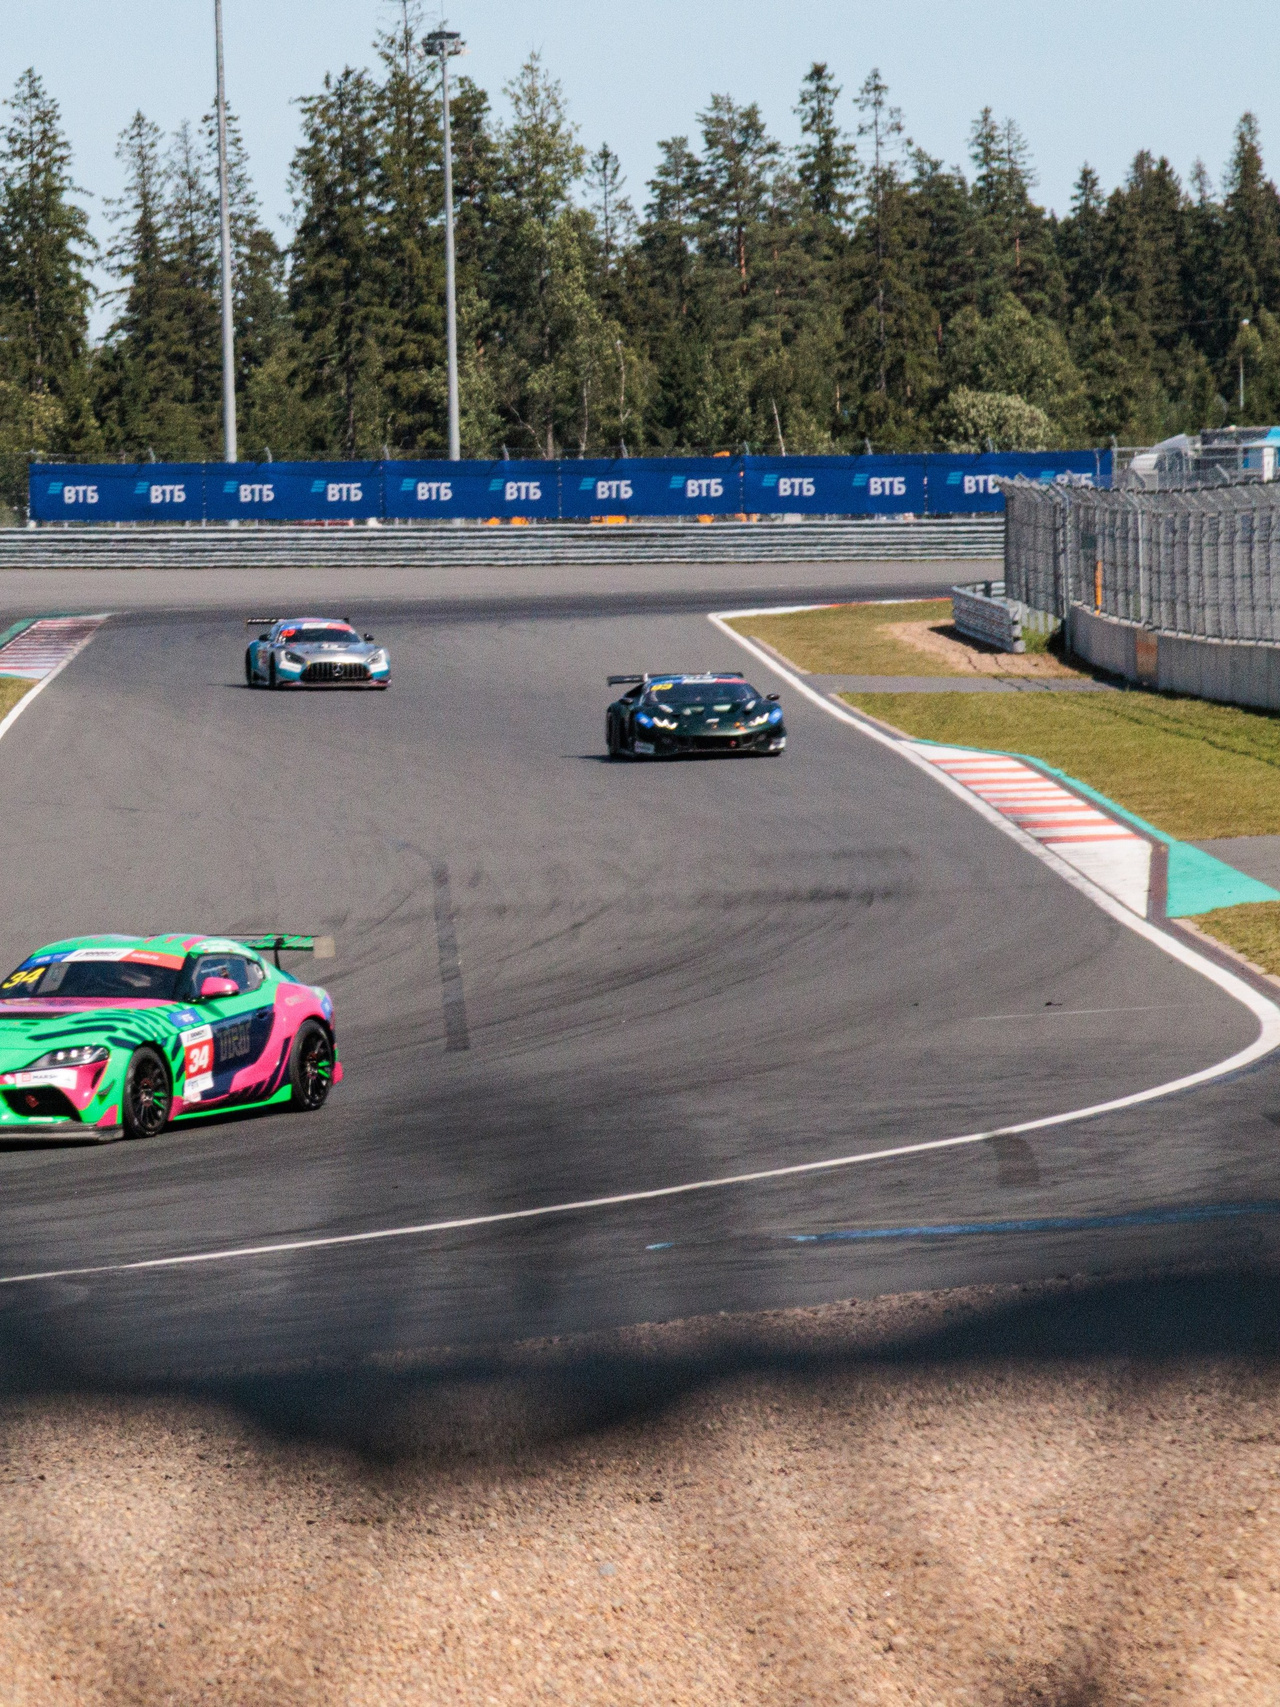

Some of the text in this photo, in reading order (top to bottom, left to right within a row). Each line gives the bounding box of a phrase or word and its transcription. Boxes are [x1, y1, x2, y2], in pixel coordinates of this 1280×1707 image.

[64, 486, 99, 504] ВТБ
[151, 485, 186, 503] ВТБ
[239, 484, 275, 503] ВТБ
[327, 483, 363, 502] ВТБ
[417, 482, 453, 501] ВТБ
[505, 482, 542, 500] ВТБ
[596, 480, 633, 499] ВТБ
[686, 479, 724, 498] ВТБ
[778, 478, 816, 496] ВТБ
[869, 477, 906, 496] ВТБ
[2, 967, 46, 989] 34
[188, 1045, 209, 1073] 34
